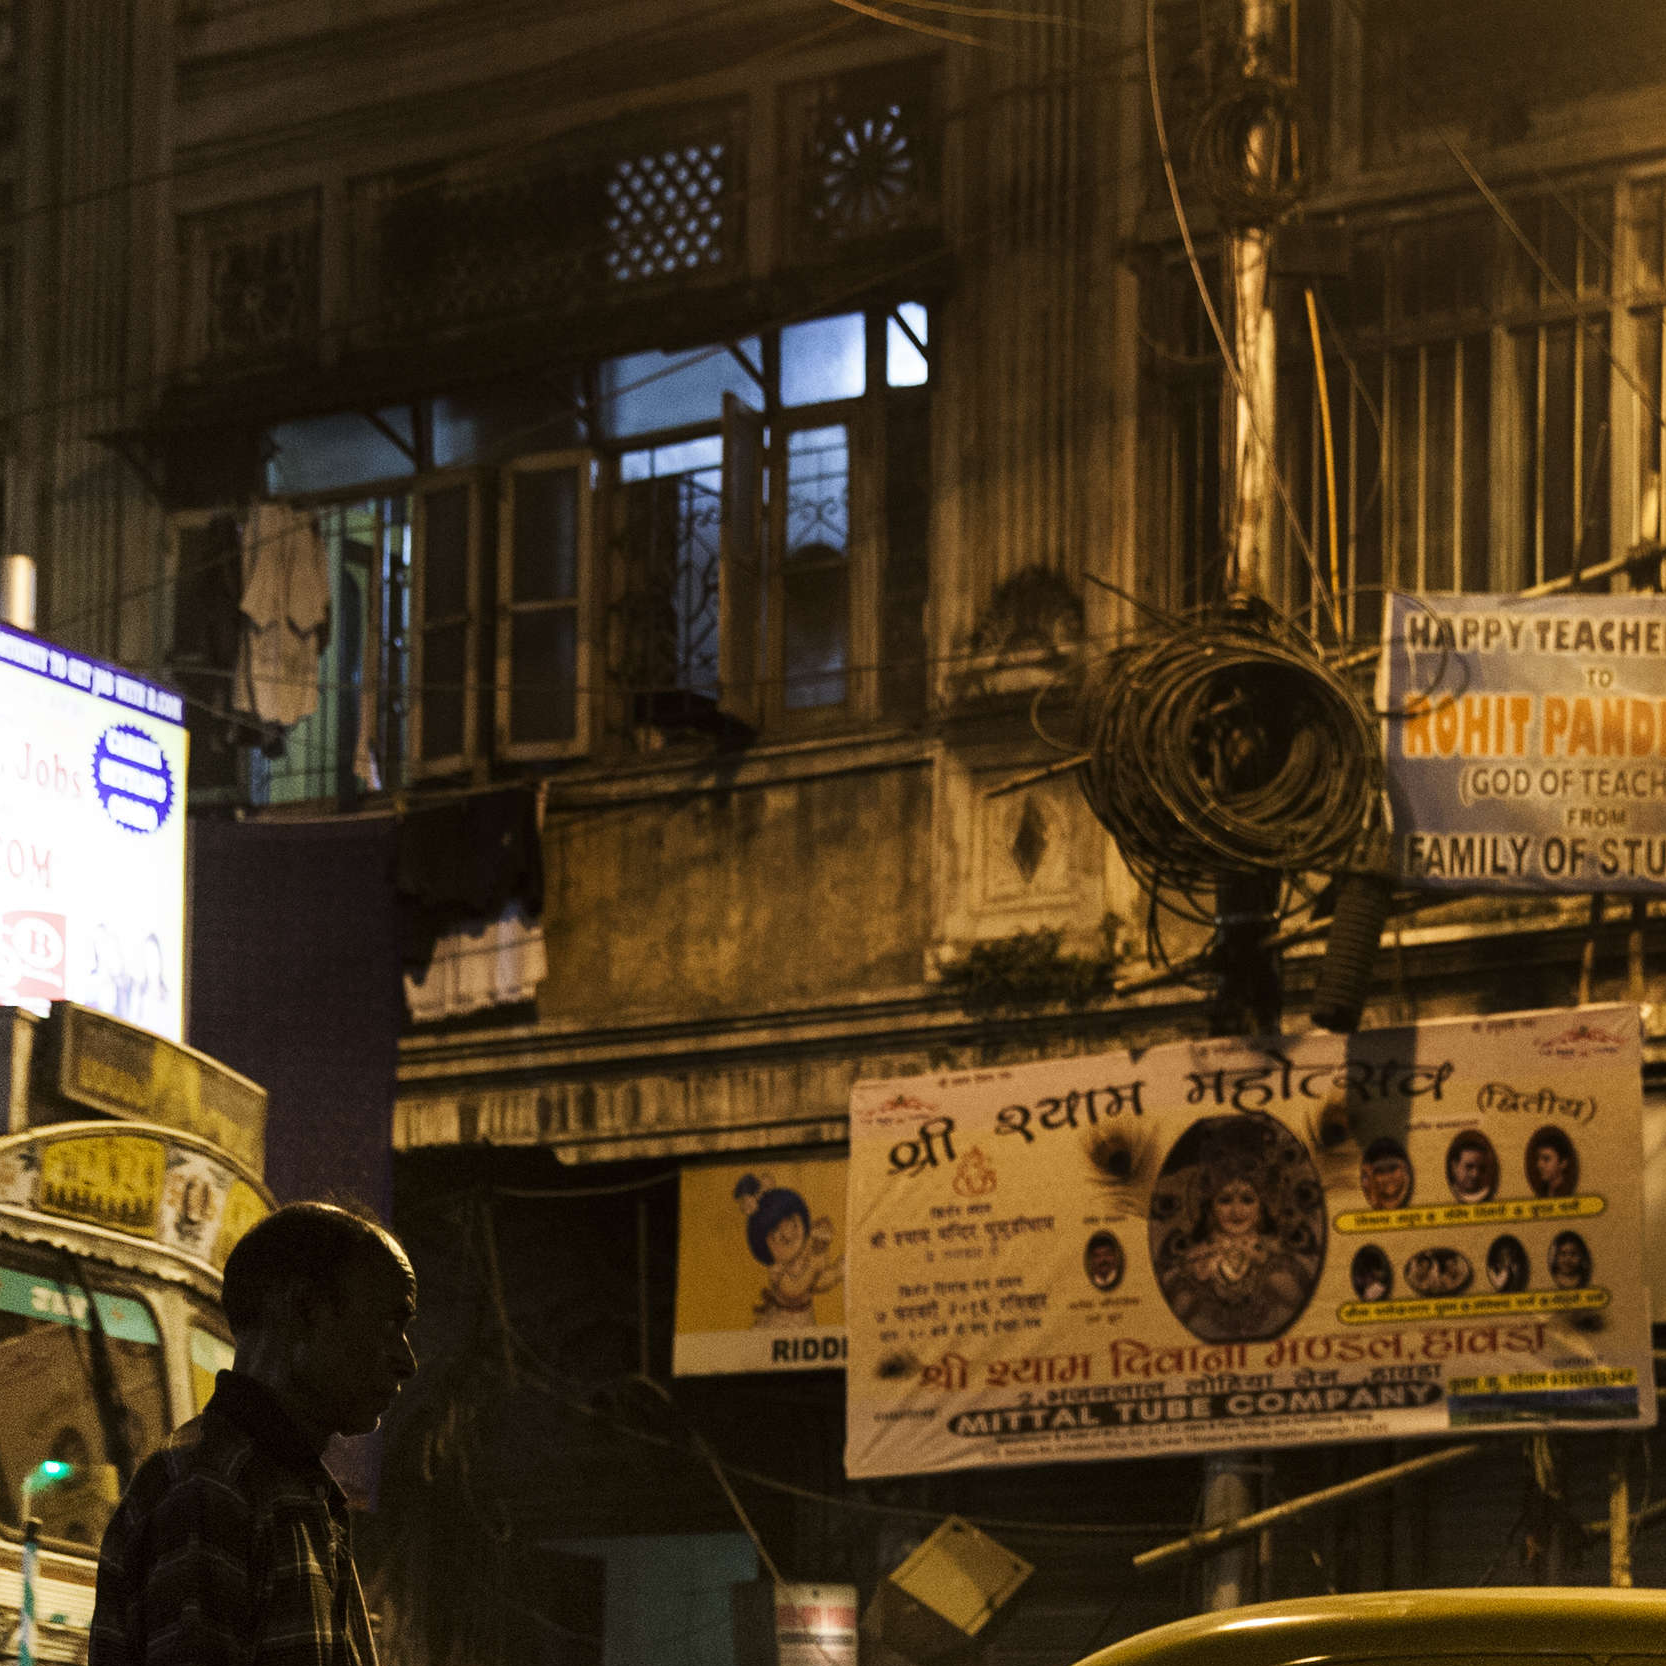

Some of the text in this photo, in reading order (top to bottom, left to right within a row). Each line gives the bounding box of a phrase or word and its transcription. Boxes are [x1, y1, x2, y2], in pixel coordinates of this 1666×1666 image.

[1408, 617, 1523, 650] HAPPY
[1587, 669, 1613, 689] TO
[1404, 695, 1531, 757] ROHIT
[17, 742, 82, 800] Jobs
[1541, 767, 1574, 793] OF
[1567, 808, 1627, 827] FROM
[1406, 835, 1531, 875] FAMILY
[1542, 836, 1589, 875] OF
[887, 1115, 957, 1178] श्री
[993, 1080, 1146, 1145] श्याम
[1184, 1048, 1455, 1113] महोत्सव
[918, 1351, 970, 1391] श्री
[985, 1351, 1092, 1387] श्याम
[955, 1404, 1101, 1435] MITTAL
[1113, 1396, 1212, 1423] TUBE
[1224, 1382, 1433, 1417] COMPANY
